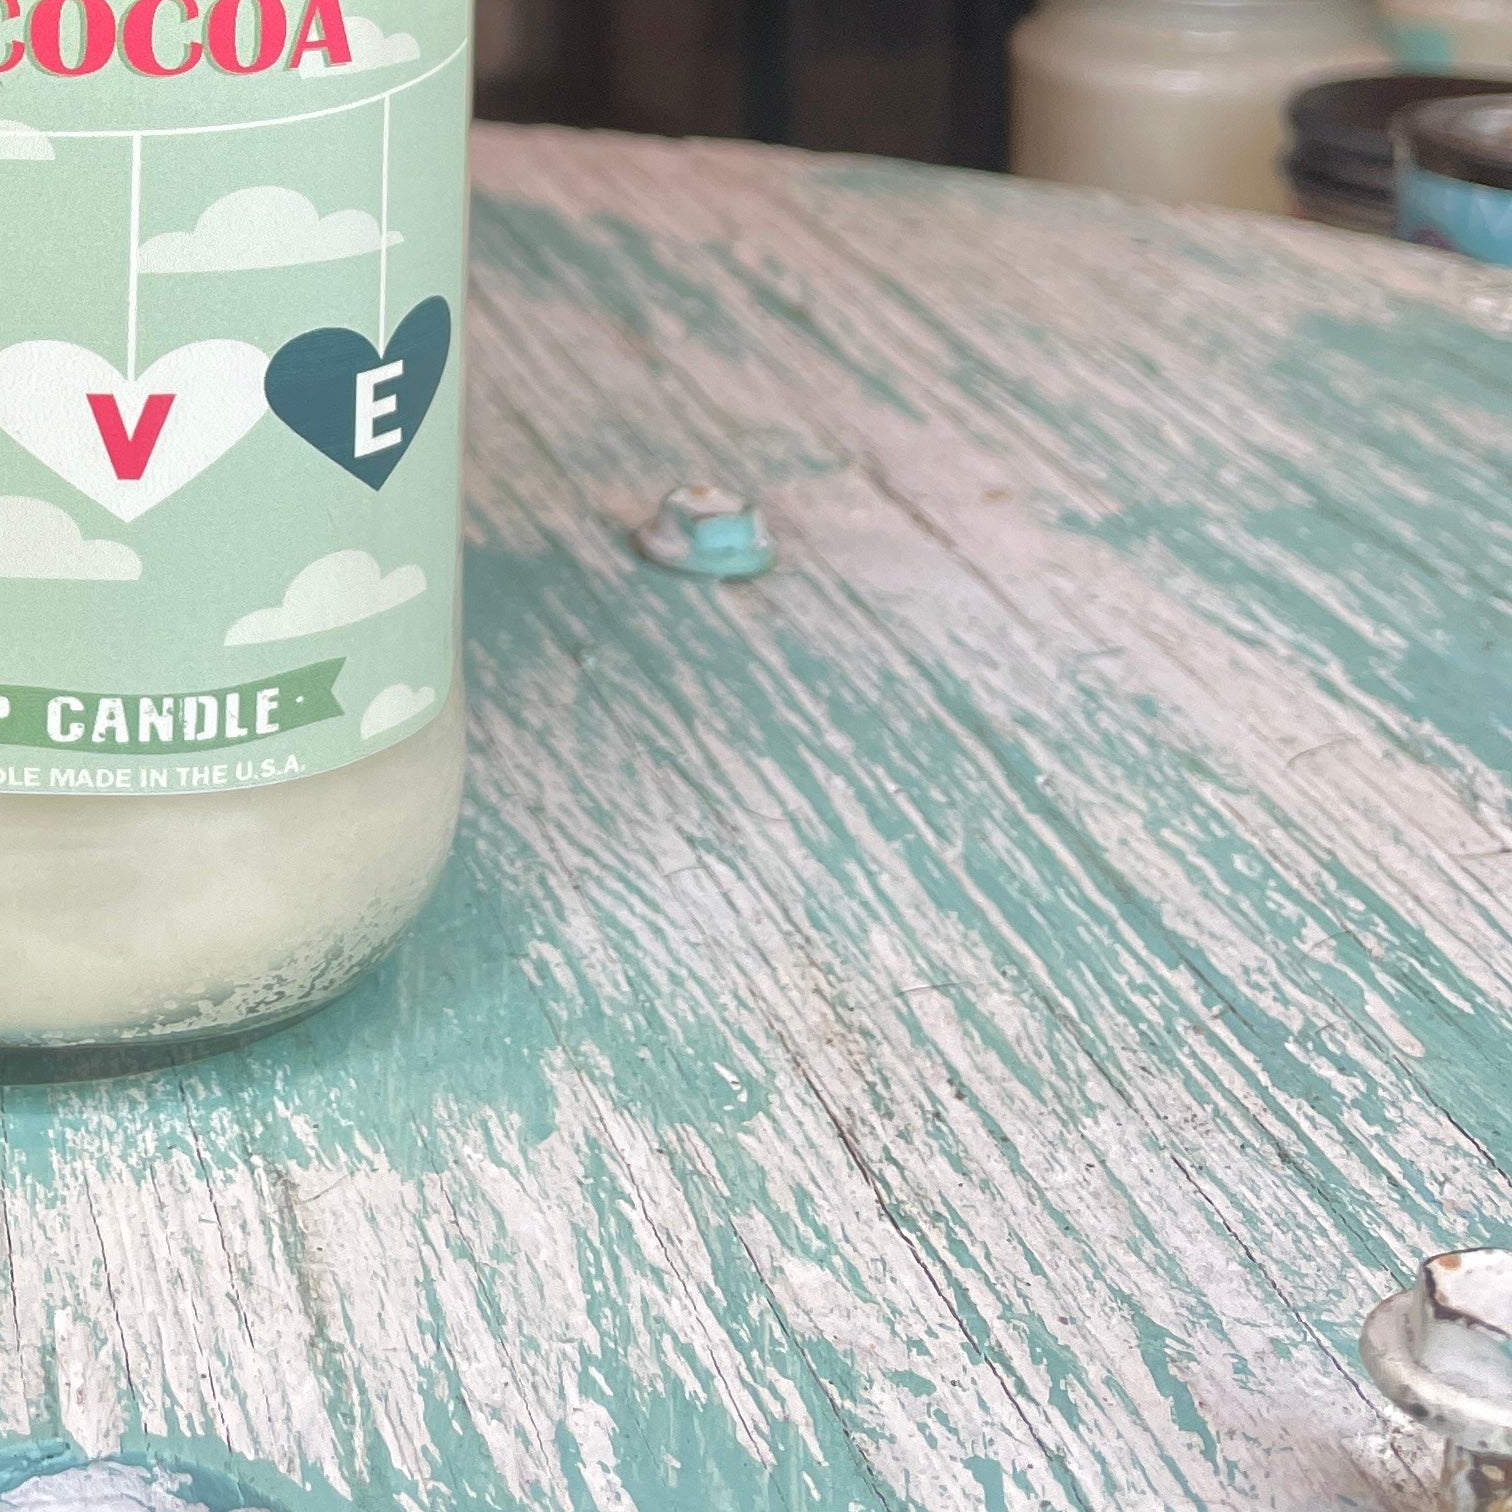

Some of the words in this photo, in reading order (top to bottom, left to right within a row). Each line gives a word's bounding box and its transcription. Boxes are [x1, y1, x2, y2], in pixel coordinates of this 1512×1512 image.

[46, 686, 281, 744] CANDLE
[48, 767, 132, 789] MADE
[139, 767, 169, 788] IN
[176, 764, 228, 787] THE
[234, 753, 307, 782] U.S.A.
